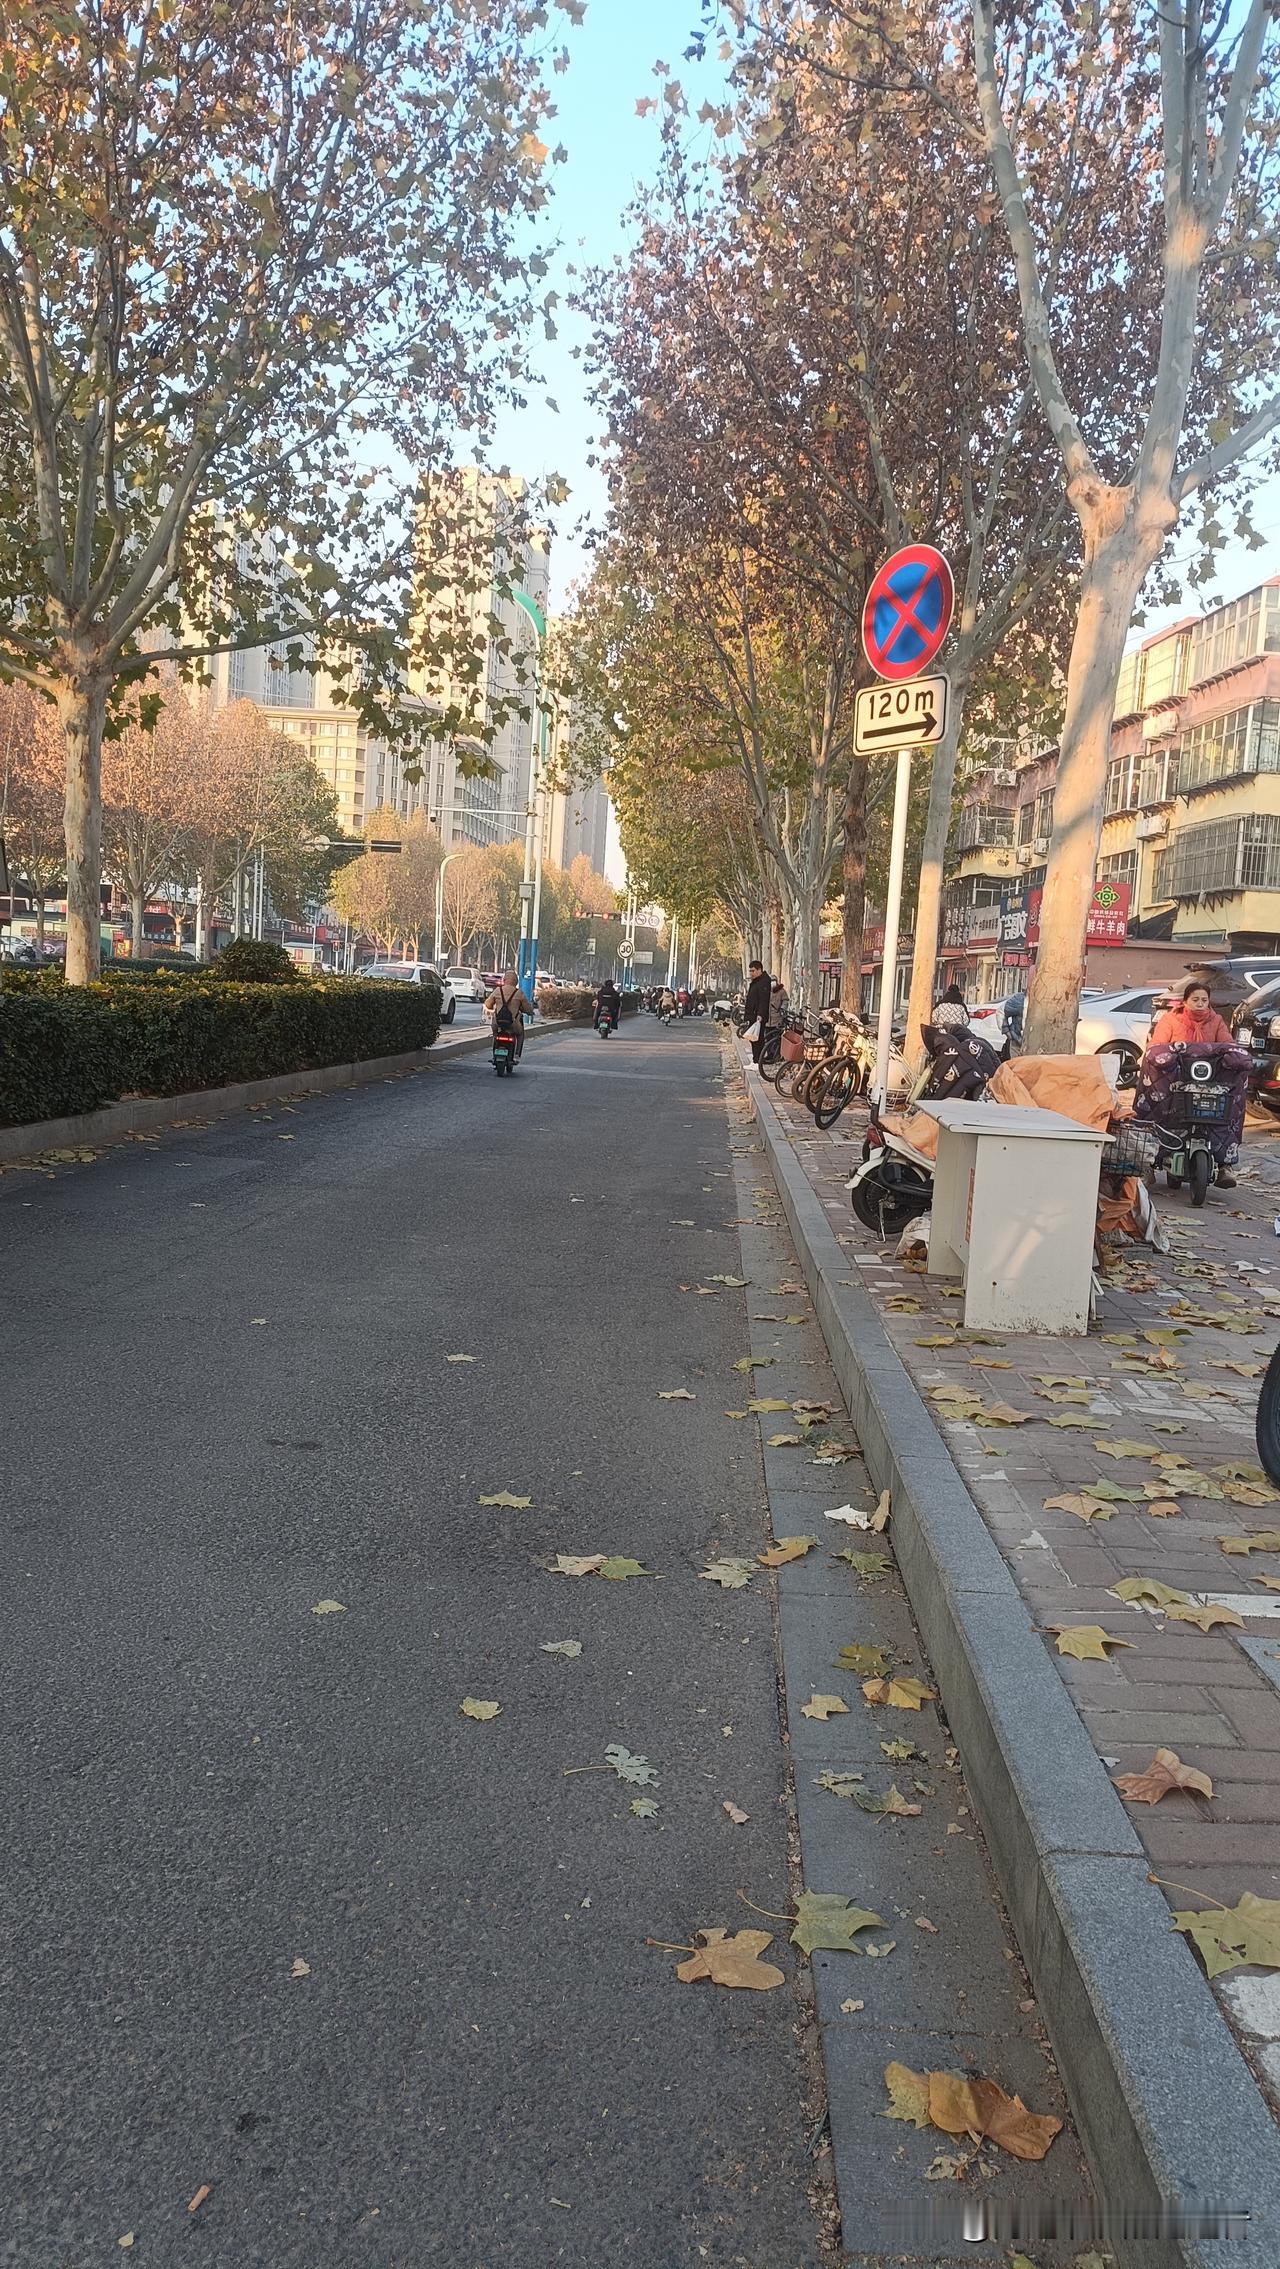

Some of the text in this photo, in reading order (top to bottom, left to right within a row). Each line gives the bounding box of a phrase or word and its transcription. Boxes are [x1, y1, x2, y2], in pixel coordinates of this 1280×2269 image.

[869, 689, 934, 720] 120m
[1087, 918, 1126, 936] 鲜牛羊肉
[620, 945, 632, 954] 30
